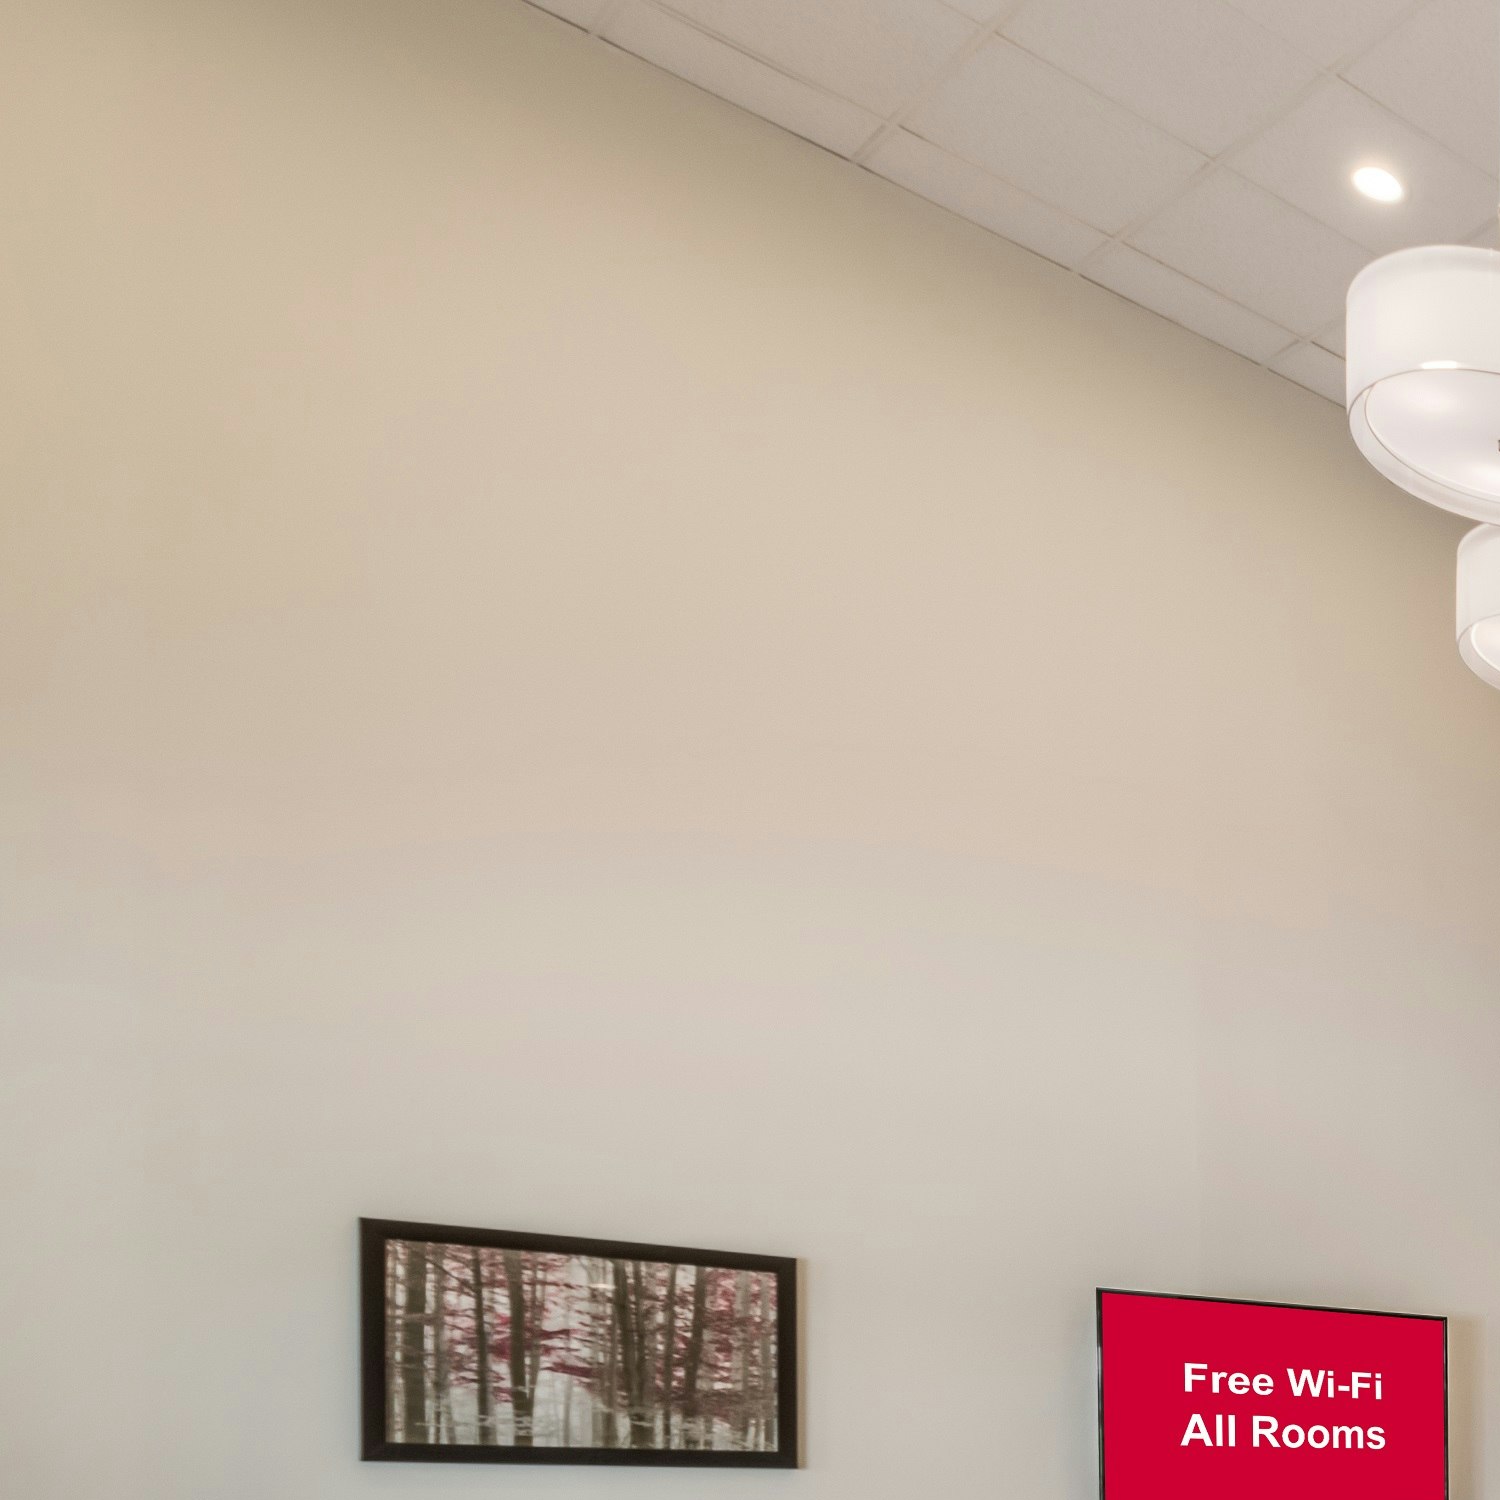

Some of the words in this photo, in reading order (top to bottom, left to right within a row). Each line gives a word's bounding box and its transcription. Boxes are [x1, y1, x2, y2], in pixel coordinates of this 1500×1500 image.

[1183, 1362, 1274, 1396] Free
[1286, 1367, 1383, 1400] Wi-Fi
[1180, 1413, 1236, 1447] All
[1252, 1414, 1386, 1450] Rooms
